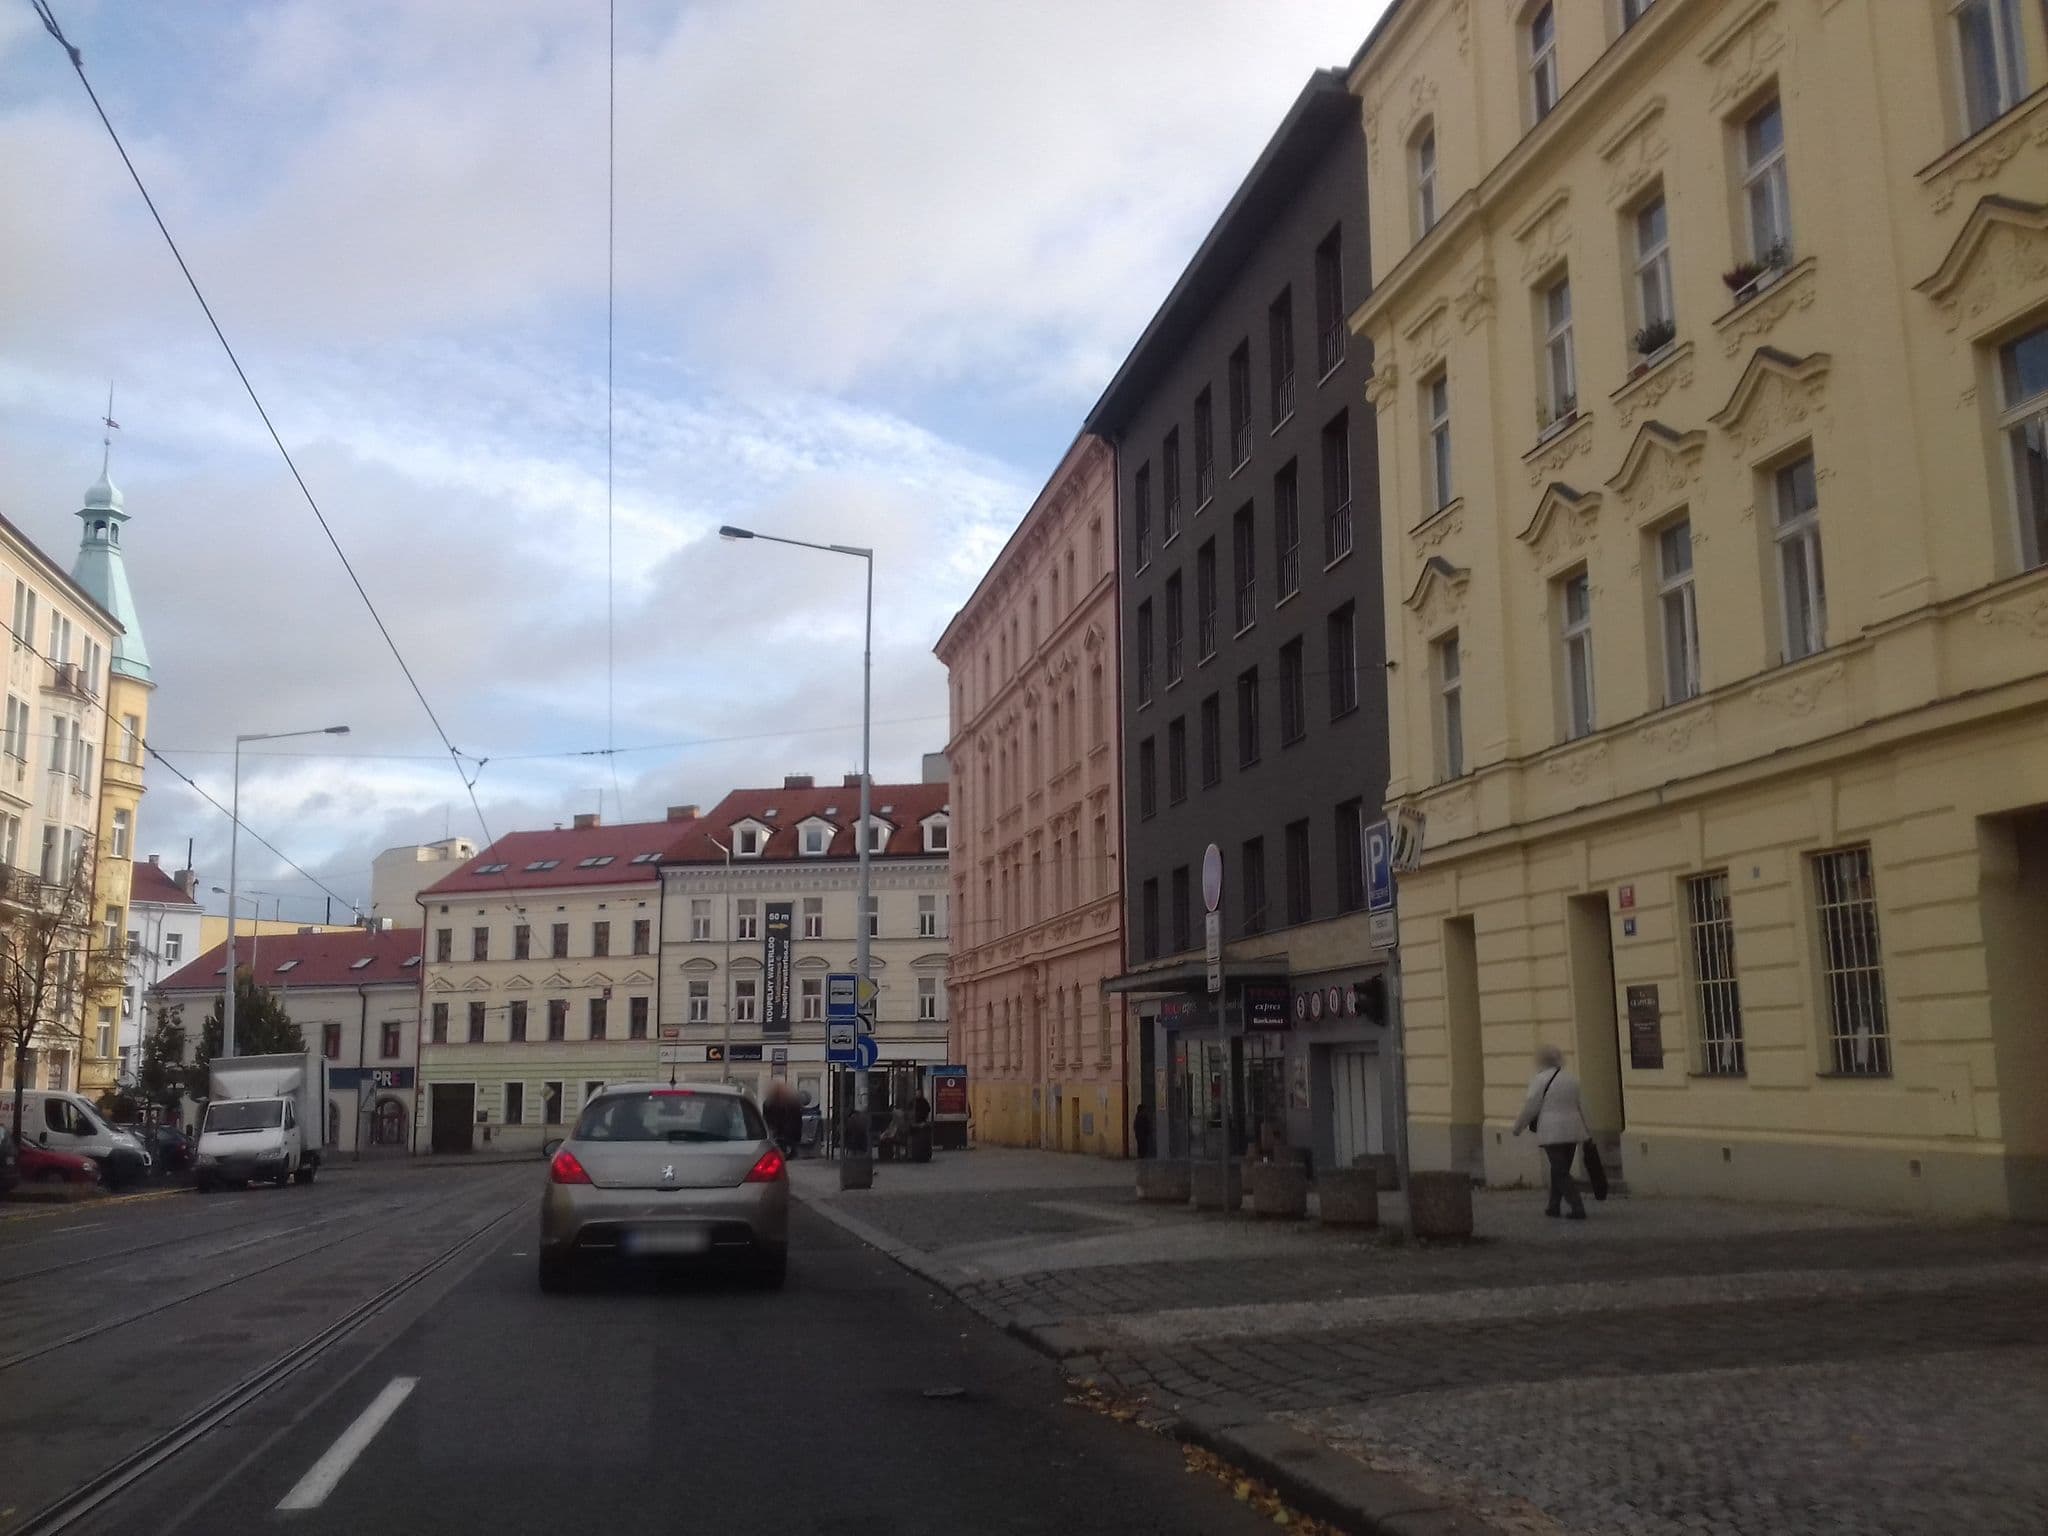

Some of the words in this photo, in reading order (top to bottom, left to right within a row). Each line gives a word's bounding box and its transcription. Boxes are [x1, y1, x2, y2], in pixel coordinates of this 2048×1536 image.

[1370, 833, 1383, 883] P
[781, 913, 790, 921] m
[767, 936, 776, 980] WATERLOO
[765, 981, 776, 1022] KOUPELNY
[372, 1070, 401, 1087] PRE
